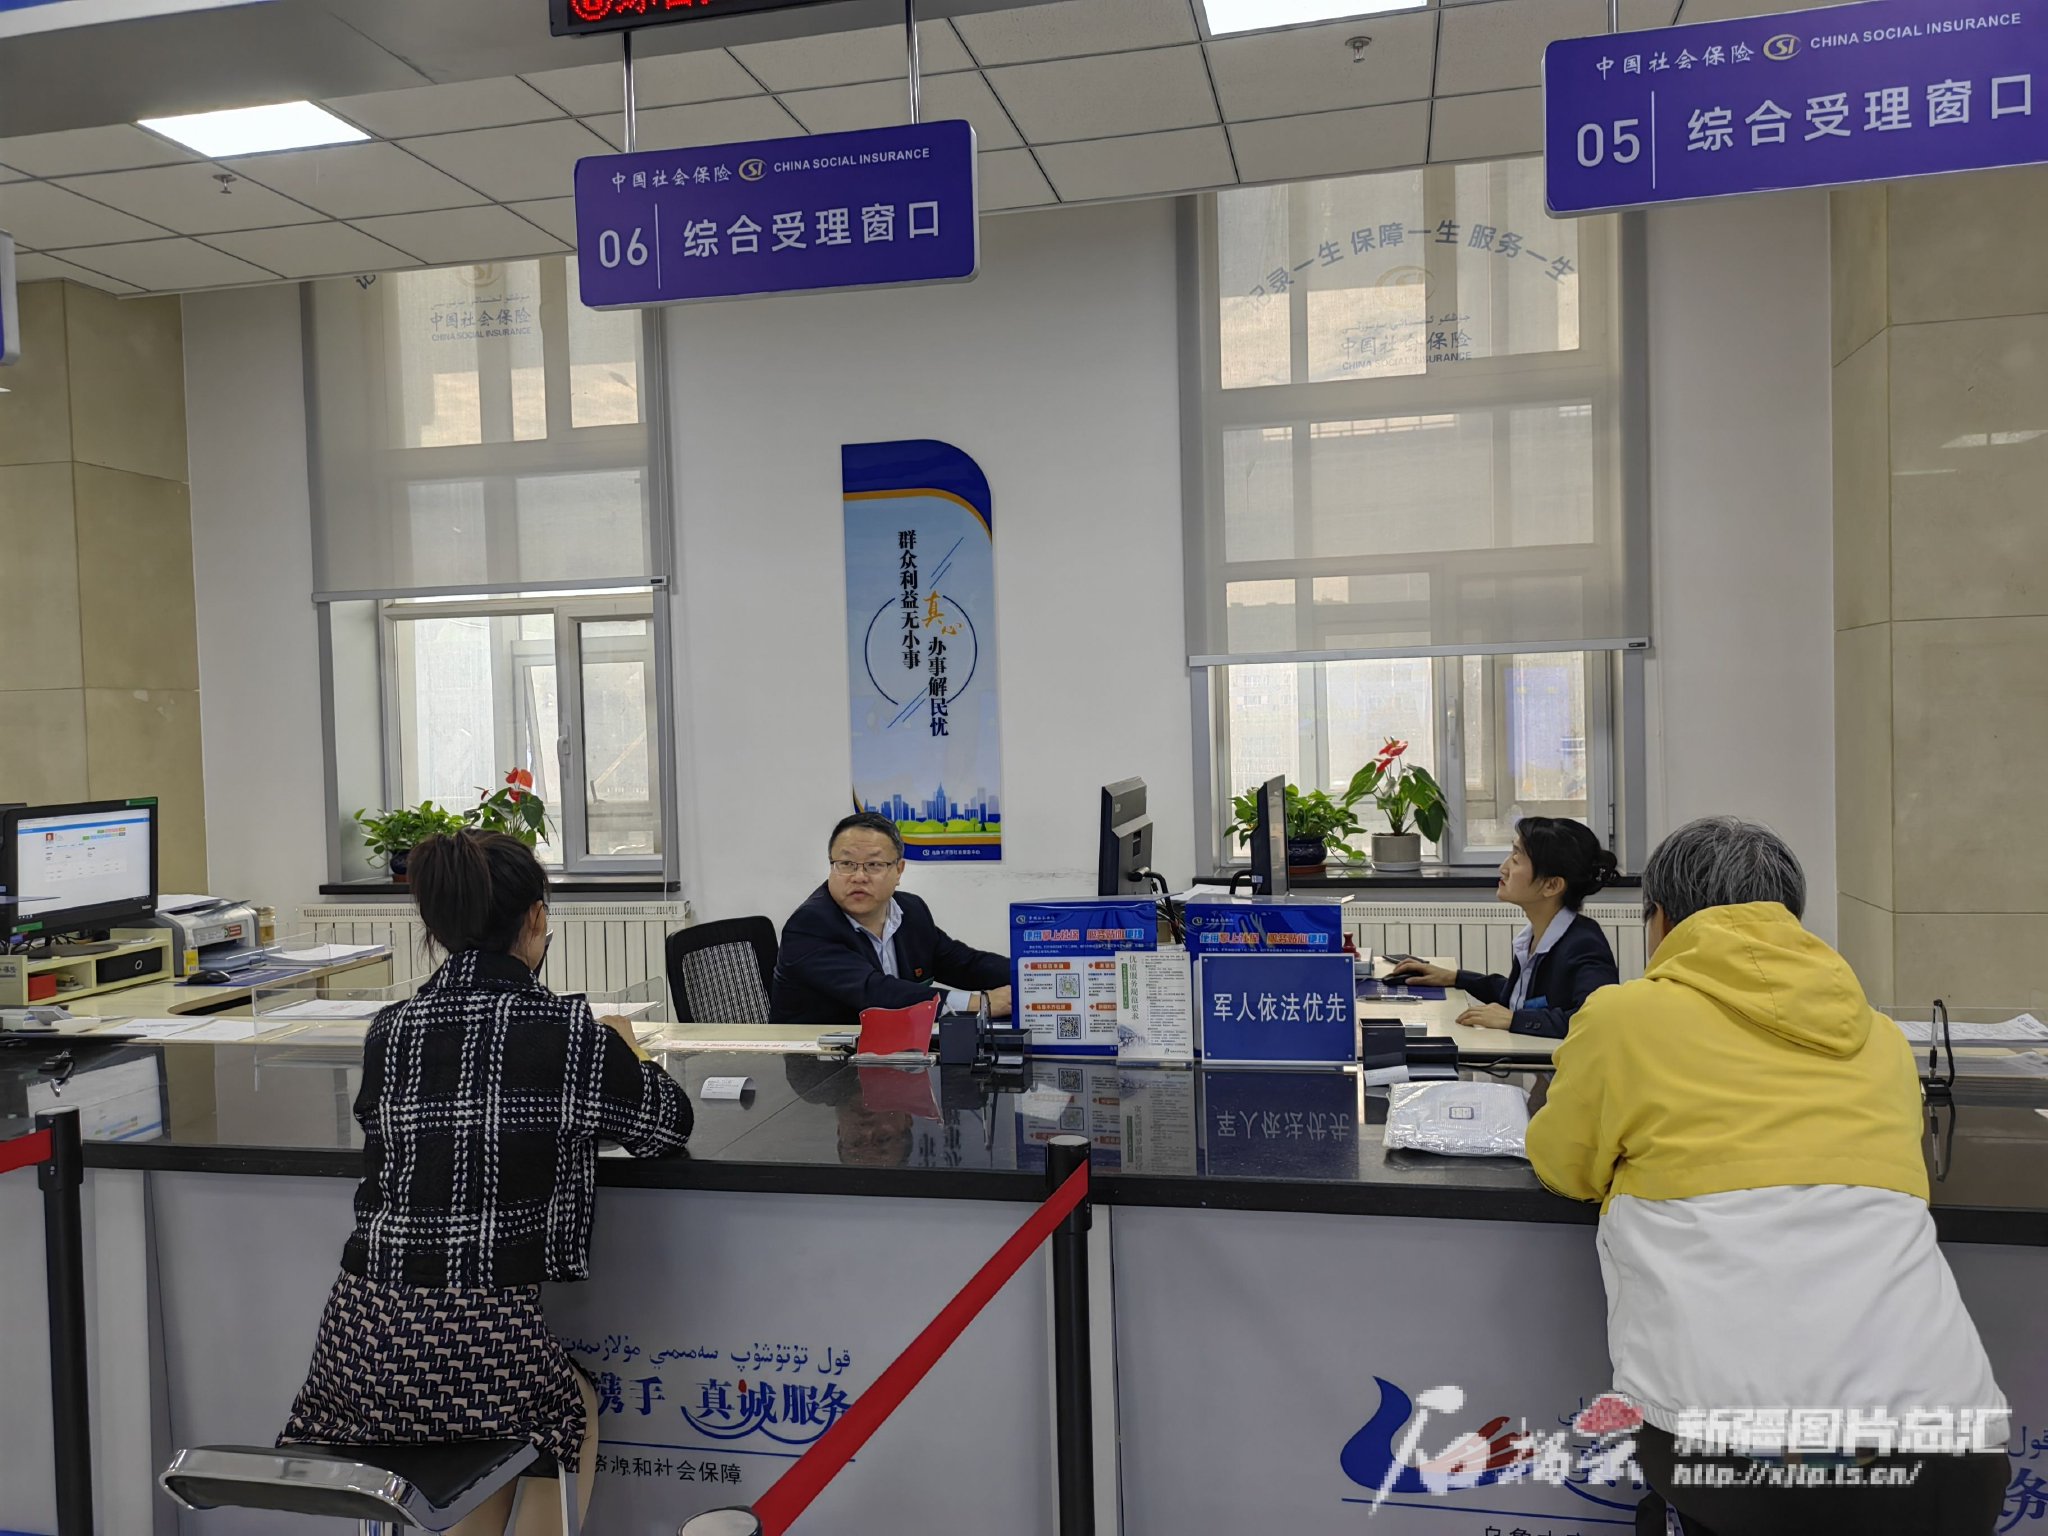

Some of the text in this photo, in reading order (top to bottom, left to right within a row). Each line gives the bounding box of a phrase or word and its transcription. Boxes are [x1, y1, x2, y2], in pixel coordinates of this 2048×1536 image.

[1810, 12, 2021, 49] CHINA SOCIAL INSURANCE
[1596, 42, 1755, 80] 中国社会保险
[1687, 73, 2033, 152] 综合受理窗口
[774, 147, 930, 173] CHINA SOCIAL INSURANCE
[1576, 118, 1641, 168] 05
[612, 163, 732, 193] 中国社会保险
[599, 228, 648, 268] 06
[683, 200, 940, 258] 综合受理窗口
[1350, 219, 1461, 256] 保障一生
[1467, 223, 1577, 286] 服务一生
[430, 307, 532, 332] 中国社会保险
[897, 529, 922, 671] 群众利益无小事
[927, 636, 950, 738] 办事解民忧
[1213, 992, 1347, 1023] 军人依法优先
[695, 1378, 853, 1430] 真诚服务
